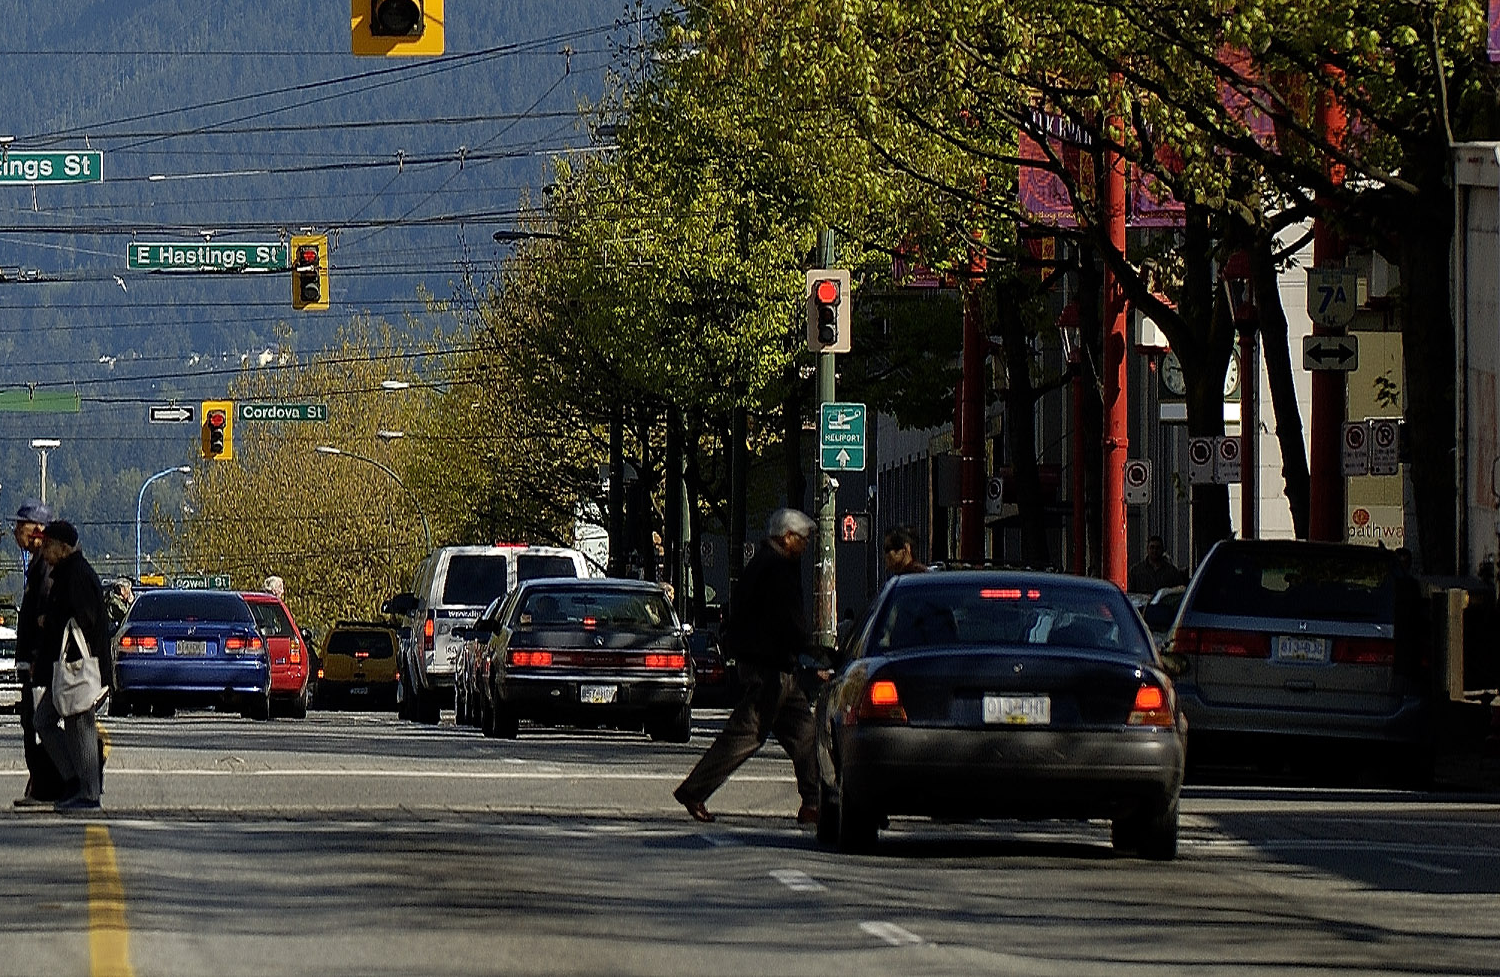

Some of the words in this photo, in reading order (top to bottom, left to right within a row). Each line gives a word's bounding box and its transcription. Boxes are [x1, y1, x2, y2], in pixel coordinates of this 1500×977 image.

[64, 155, 91, 176] St
[137, 246, 150, 263] E
[159, 246, 247, 267] Hastings
[256, 246, 279, 263] St
[1318, 286, 1346, 313] 7A
[242, 406, 300, 419] Cordova
[307, 405, 322, 418] St
[825, 434, 860, 442] HELIPORT
